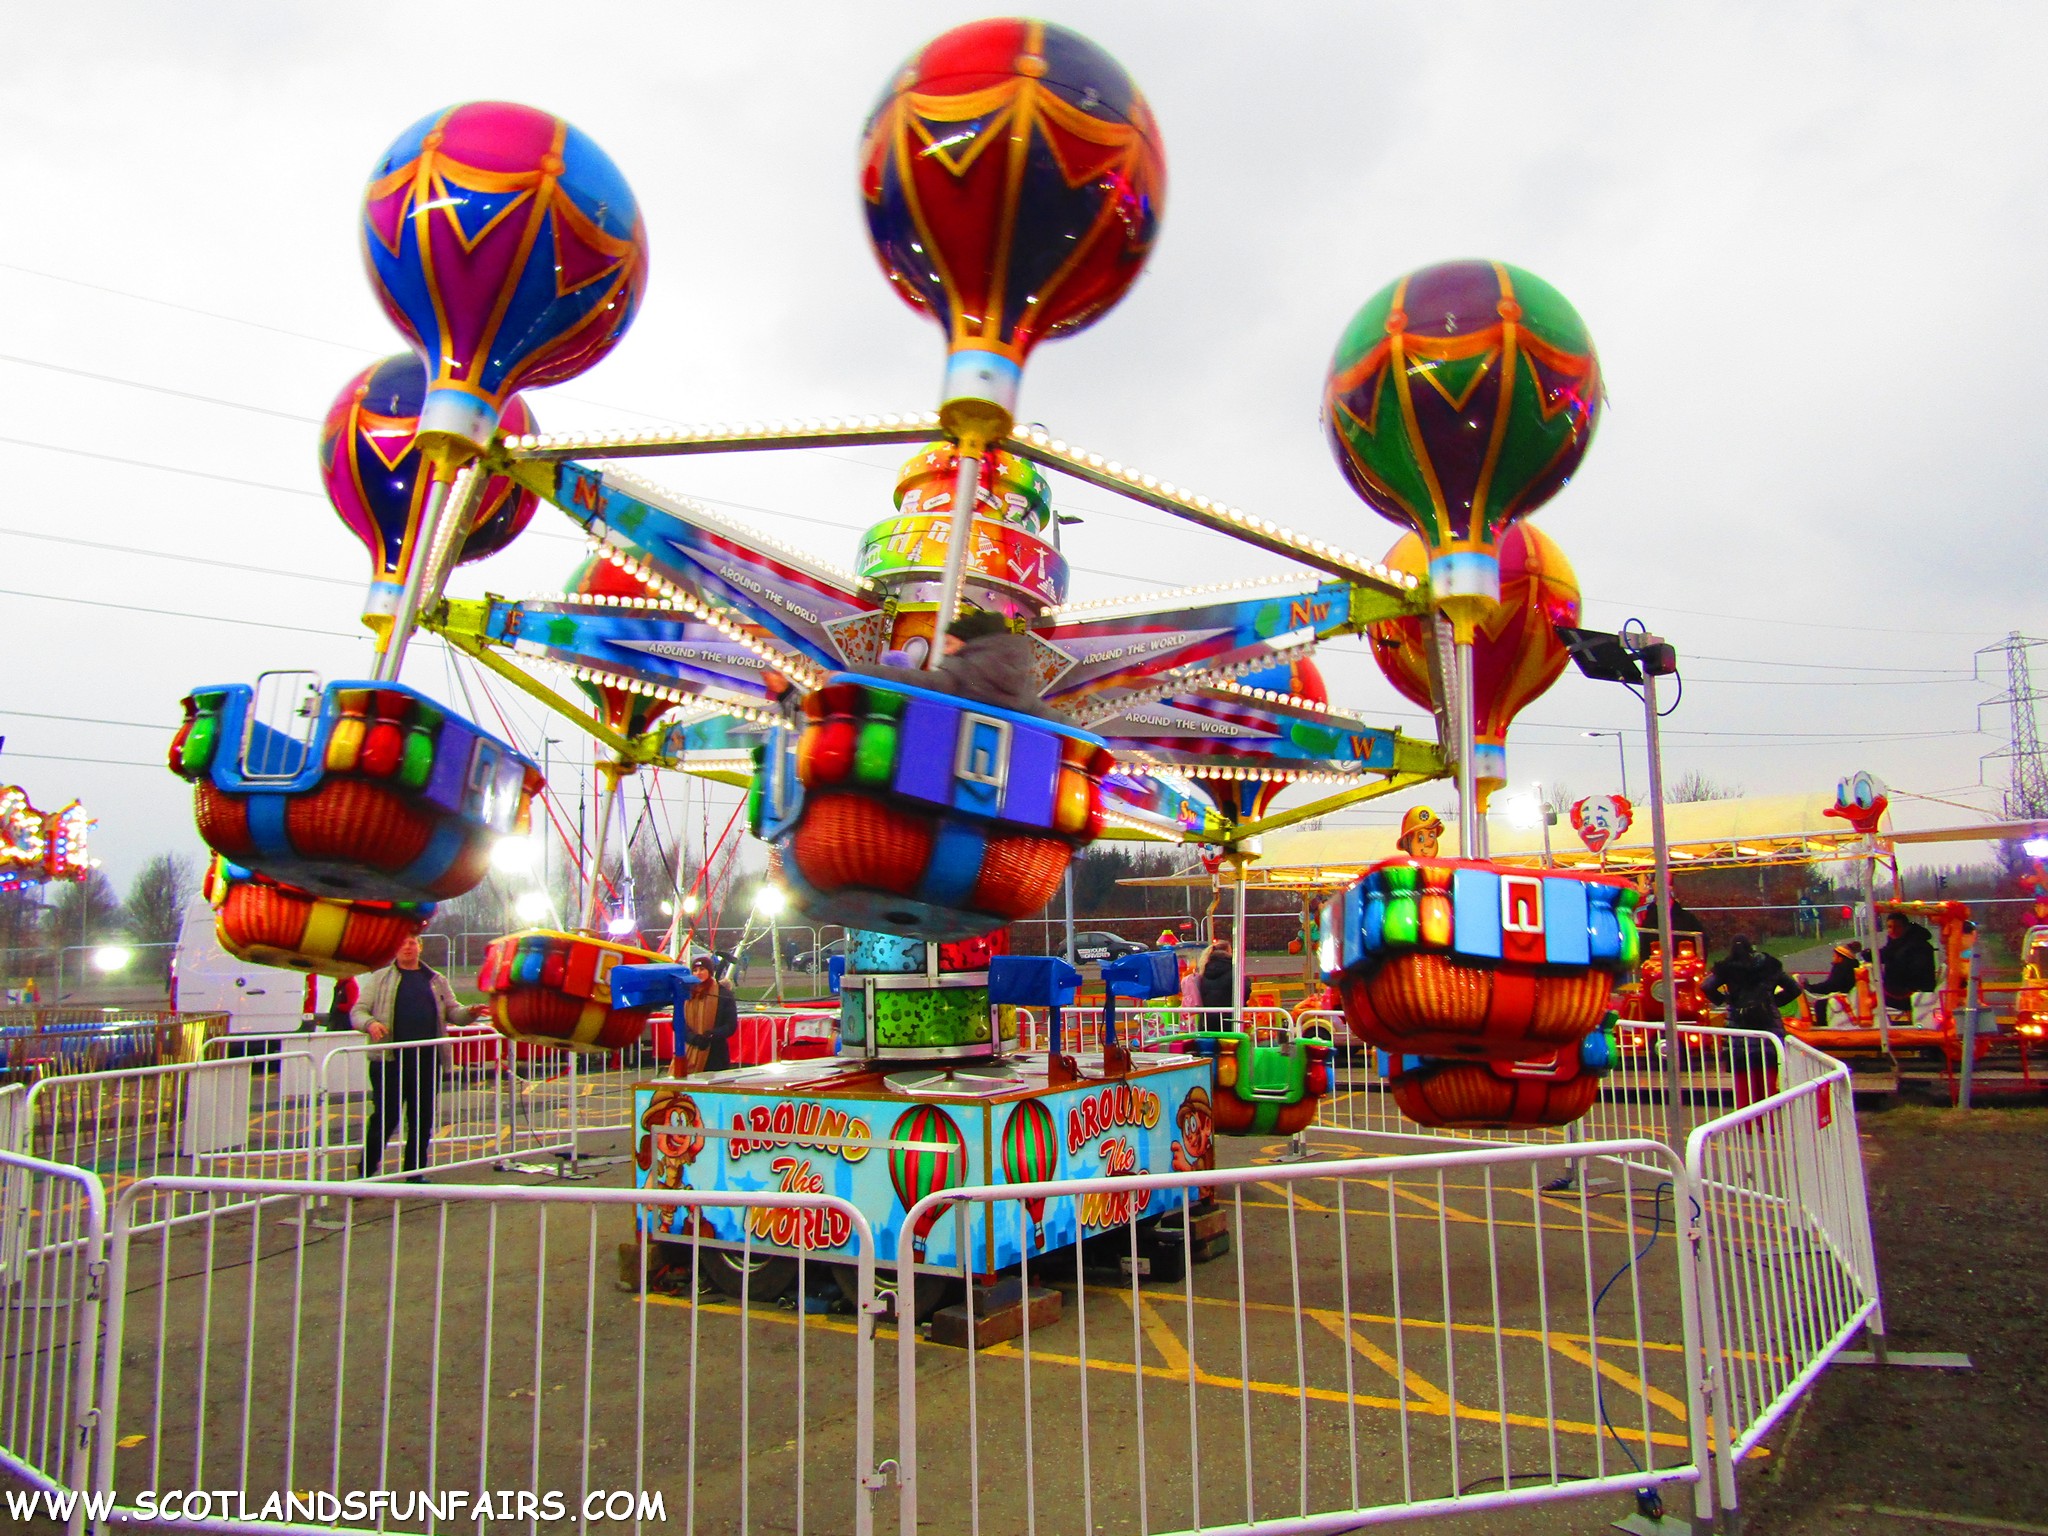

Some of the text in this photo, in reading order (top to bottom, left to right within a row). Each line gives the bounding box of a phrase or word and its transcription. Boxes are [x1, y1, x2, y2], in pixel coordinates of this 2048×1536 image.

[720, 566, 818, 624] AROUND THE WORLD
[506, 610, 524, 635] E
[649, 643, 765, 670] AROUND THE WORLD
[1082, 634, 1186, 665] AROUND THE WORLD
[1125, 712, 1239, 737] AROUND THE WORLD
[1351, 735, 1376, 759] W
[729, 1101, 872, 1161] AROUND
[1067, 1083, 1160, 1154] AROUND
[1099, 1136, 1134, 1176] The
[771, 1156, 823, 1194] The
